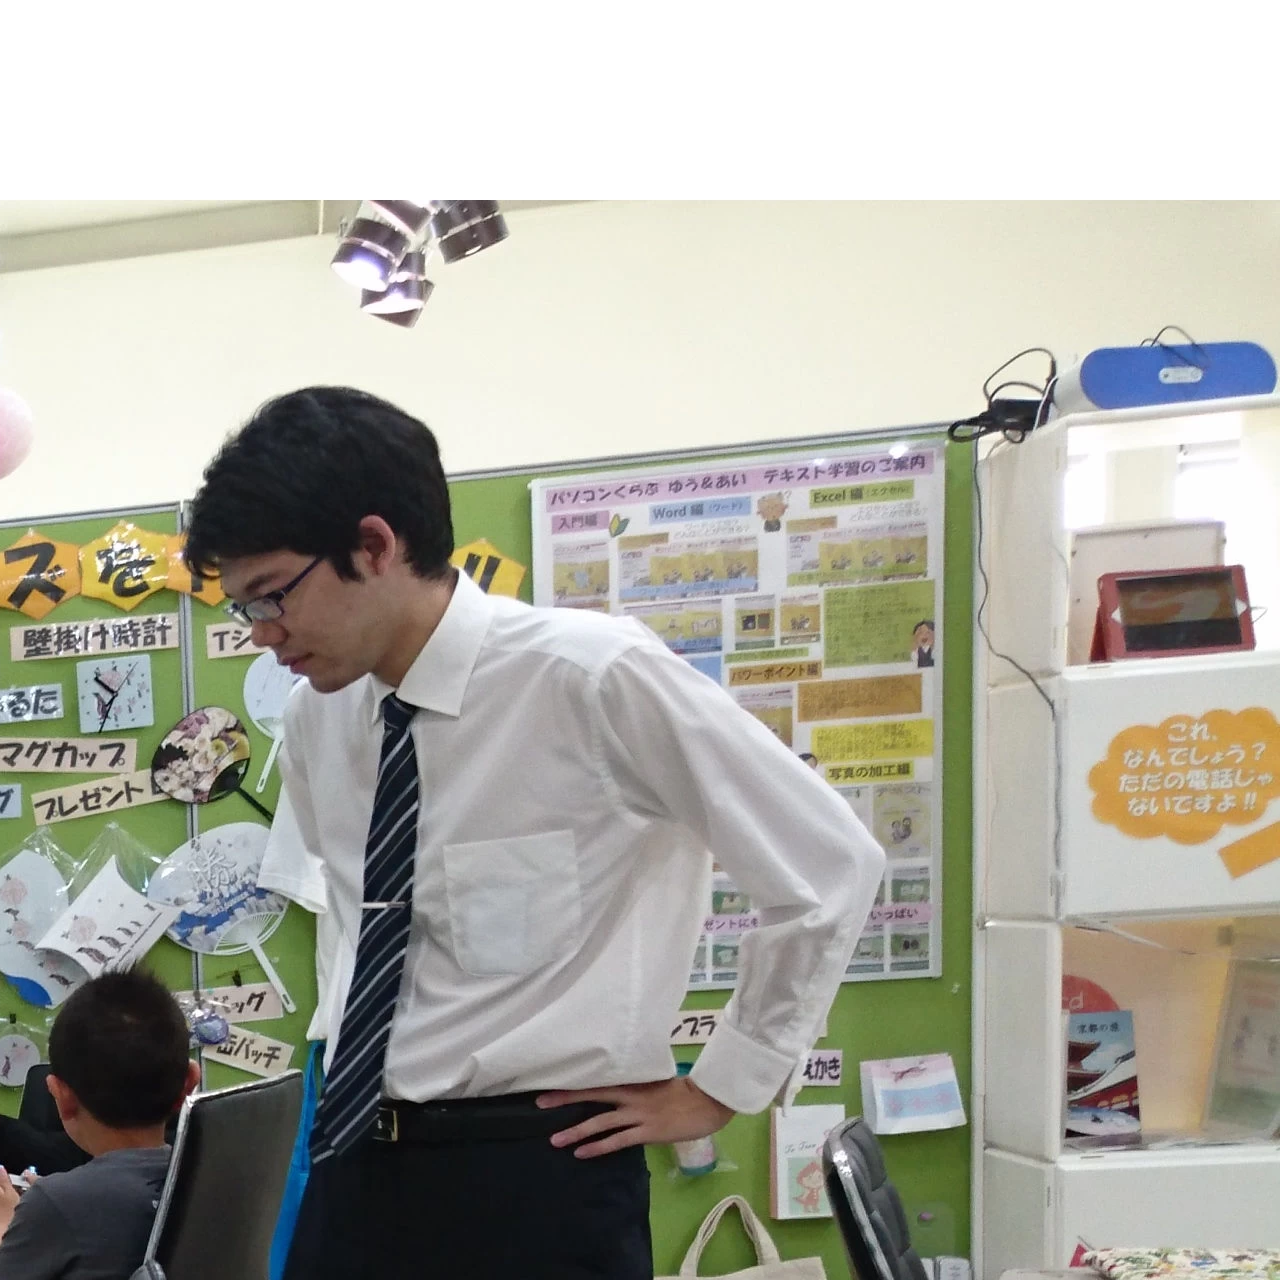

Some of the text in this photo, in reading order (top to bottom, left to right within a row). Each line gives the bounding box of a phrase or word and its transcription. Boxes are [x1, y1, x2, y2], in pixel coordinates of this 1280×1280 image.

[813, 489, 846, 503] Excel
[653, 503, 687, 519] Word
[23, 616, 173, 659] 壁掛け時計
[1118, 769, 1274, 793] ただの電話じゃ
[34, 777, 163, 823] プレゼント
